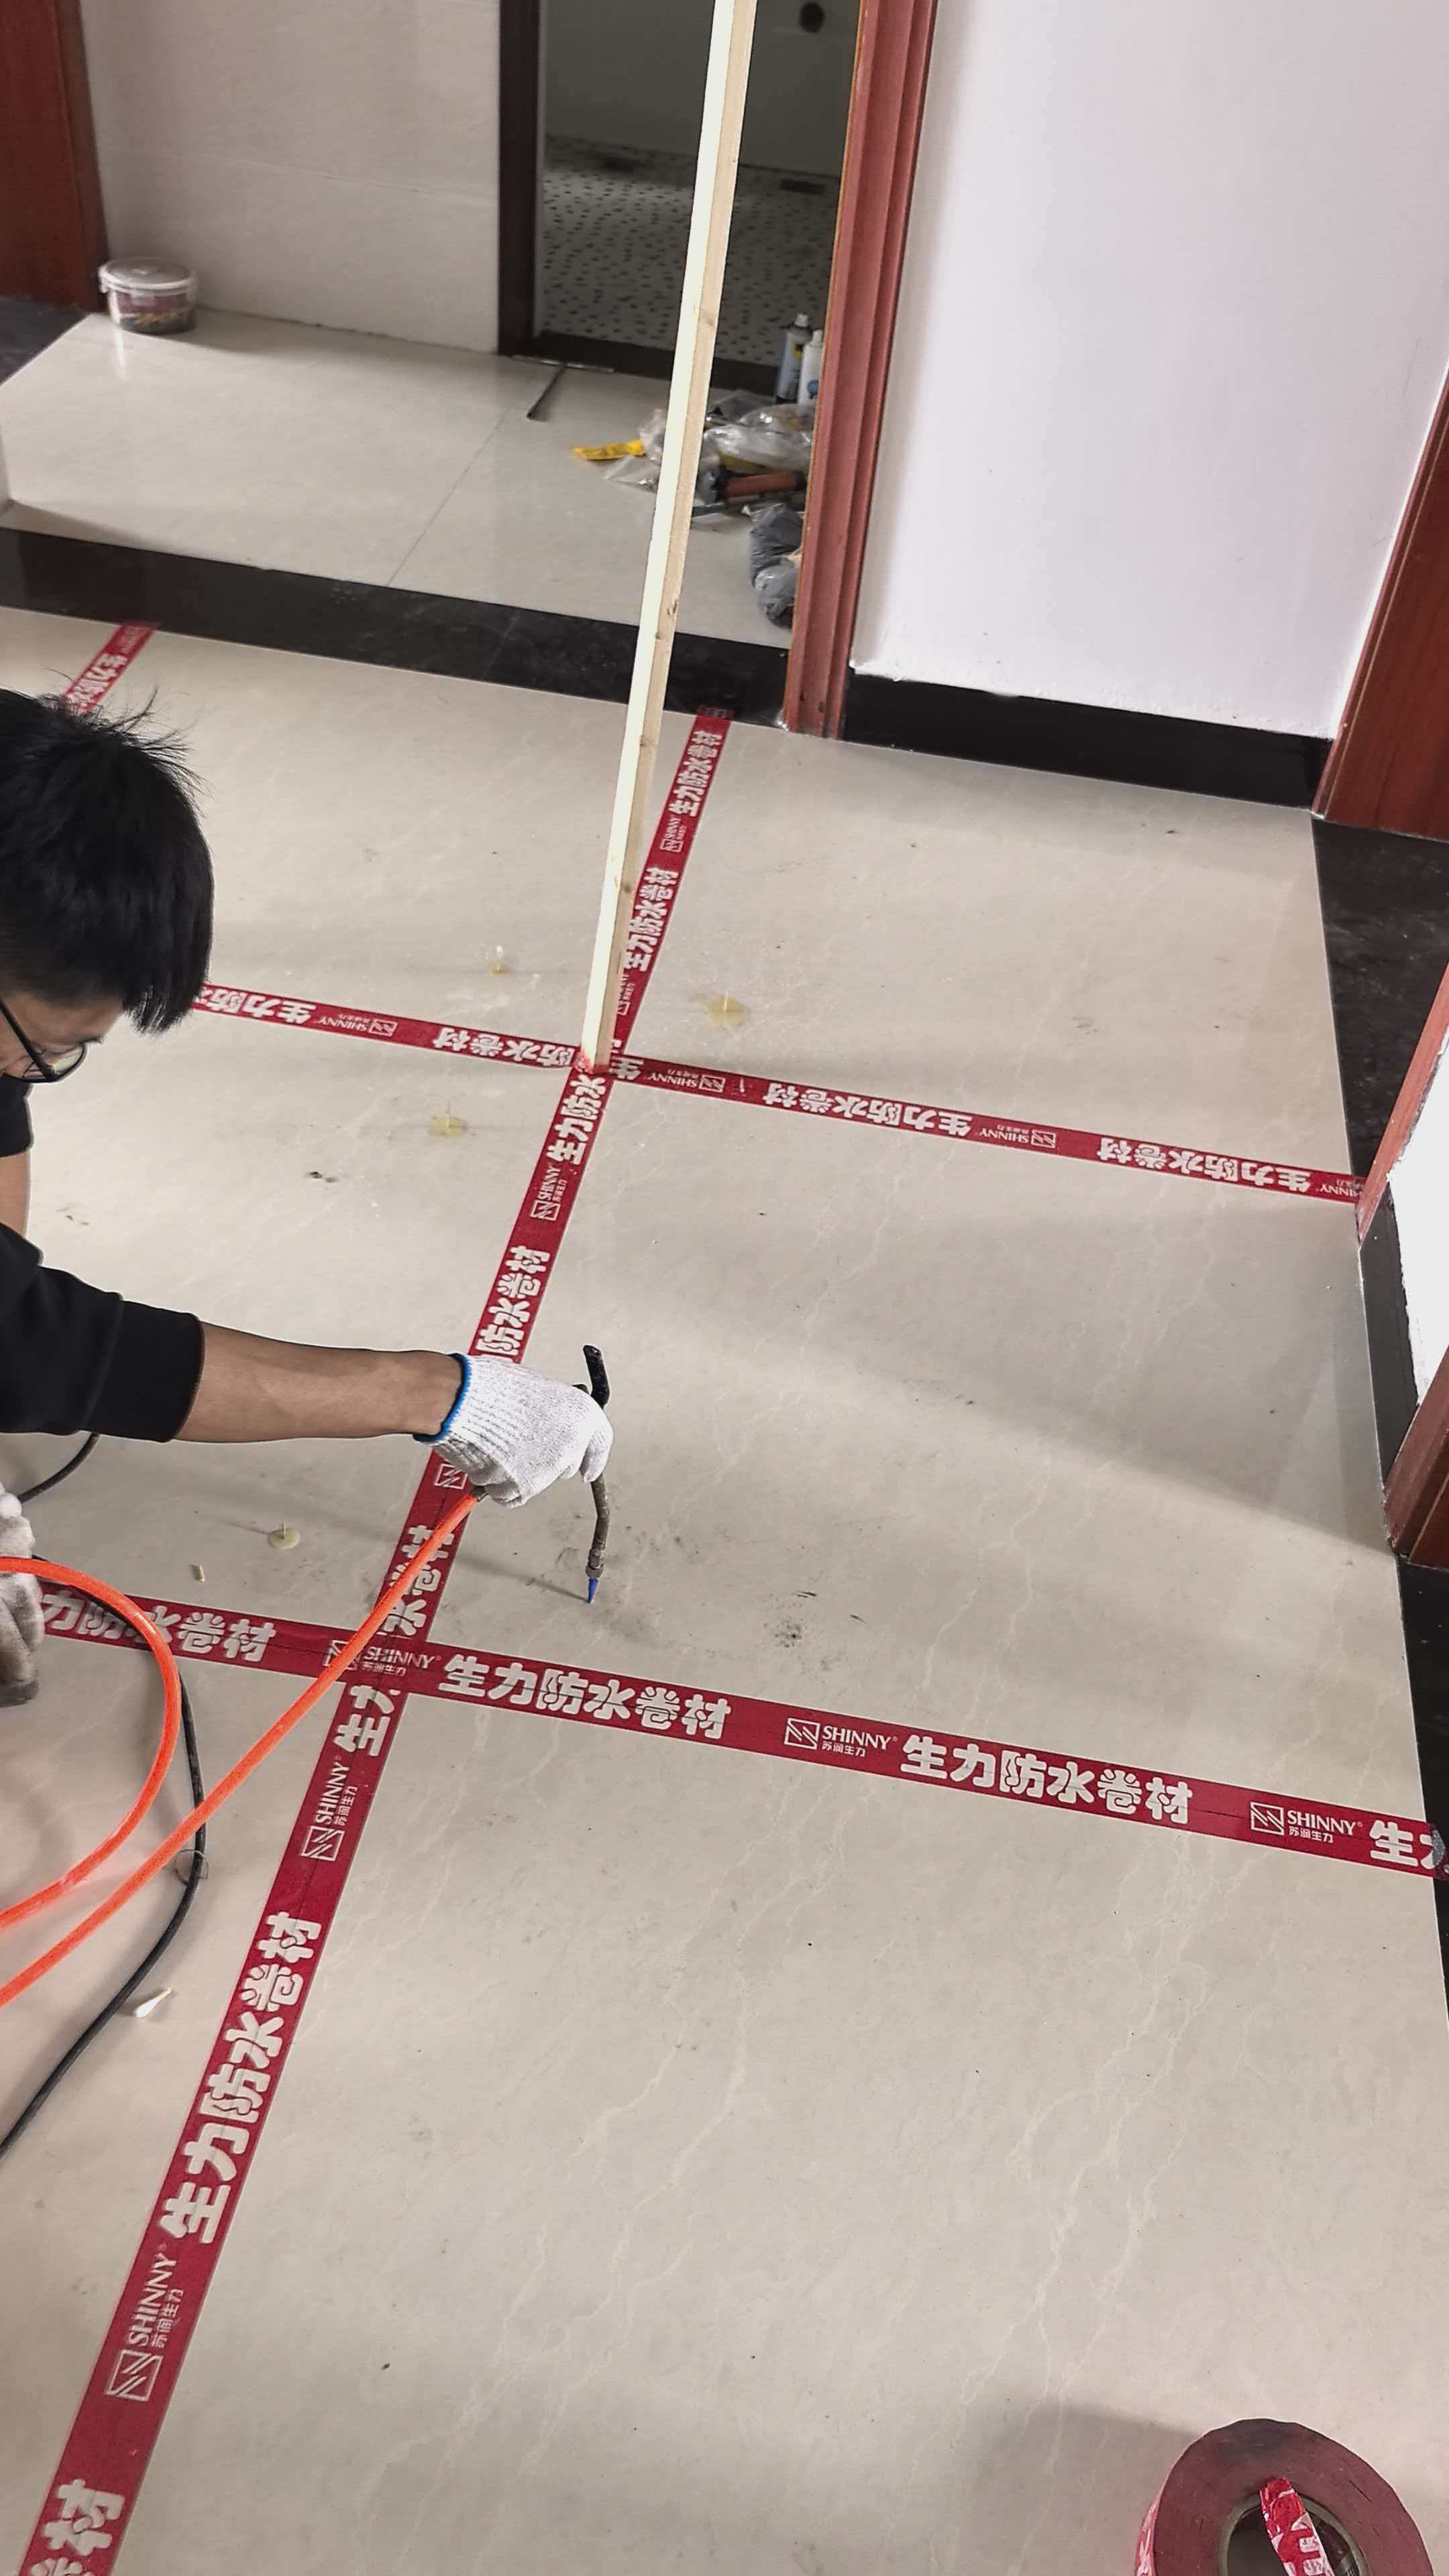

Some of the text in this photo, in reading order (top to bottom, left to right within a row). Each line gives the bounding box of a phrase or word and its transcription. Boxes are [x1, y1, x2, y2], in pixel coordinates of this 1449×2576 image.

[668, 731, 722, 816] 生力防水卷材
[622, 867, 679, 971] 生力防水卷材
[762, 1082, 972, 1136] 生力防水卷材
[979, 1128, 1029, 1144] SHINNY
[1097, 1137, 1311, 1192] 生力防水卷材
[476, 1245, 551, 1362] 防水卷材
[42, 1589, 276, 1662] 力防水卷材
[364, 1646, 435, 1669] SHINNY
[437, 1654, 731, 1739] 生力防水卷材
[822, 1725, 892, 1750] SHINNY
[315, 1762, 350, 1825] SHINNY
[900, 1735, 1193, 1825] 生力防水卷材
[1287, 1810, 1356, 1836] SHINNY
[157, 1911, 321, 2244] 生力防水卷材
[129, 2253, 177, 2347] SHINNY
